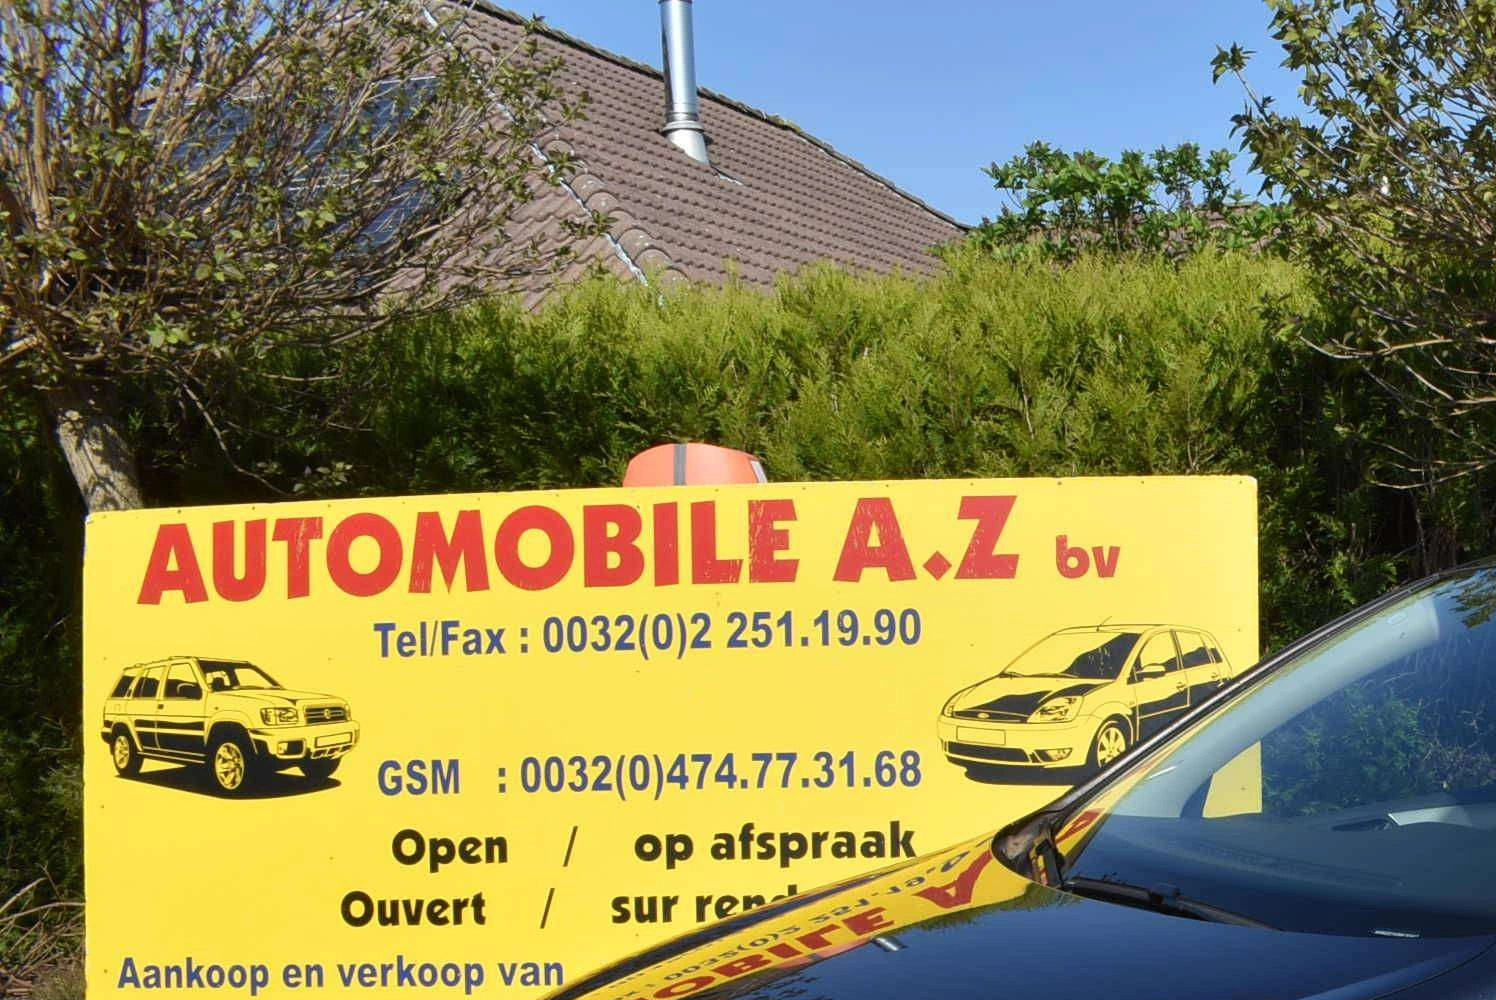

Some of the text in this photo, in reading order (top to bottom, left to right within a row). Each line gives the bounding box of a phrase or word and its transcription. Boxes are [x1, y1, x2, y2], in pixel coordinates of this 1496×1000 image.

[137, 495, 1120, 605] AUTOMOBILE A.Z bv
[374, 608, 922, 660] Tel/Fax : 0032(0)2 251.19.90
[378, 750, 923, 801] GSM : 0032(0)474.77.31.68
[392, 821, 916, 873] Open / op afspraak
[341, 891, 486, 928] Ouvert
[541, 888, 555, 929] /
[612, 893, 673, 924] sur
[118, 955, 564, 996] Aankoop en verkoop van
